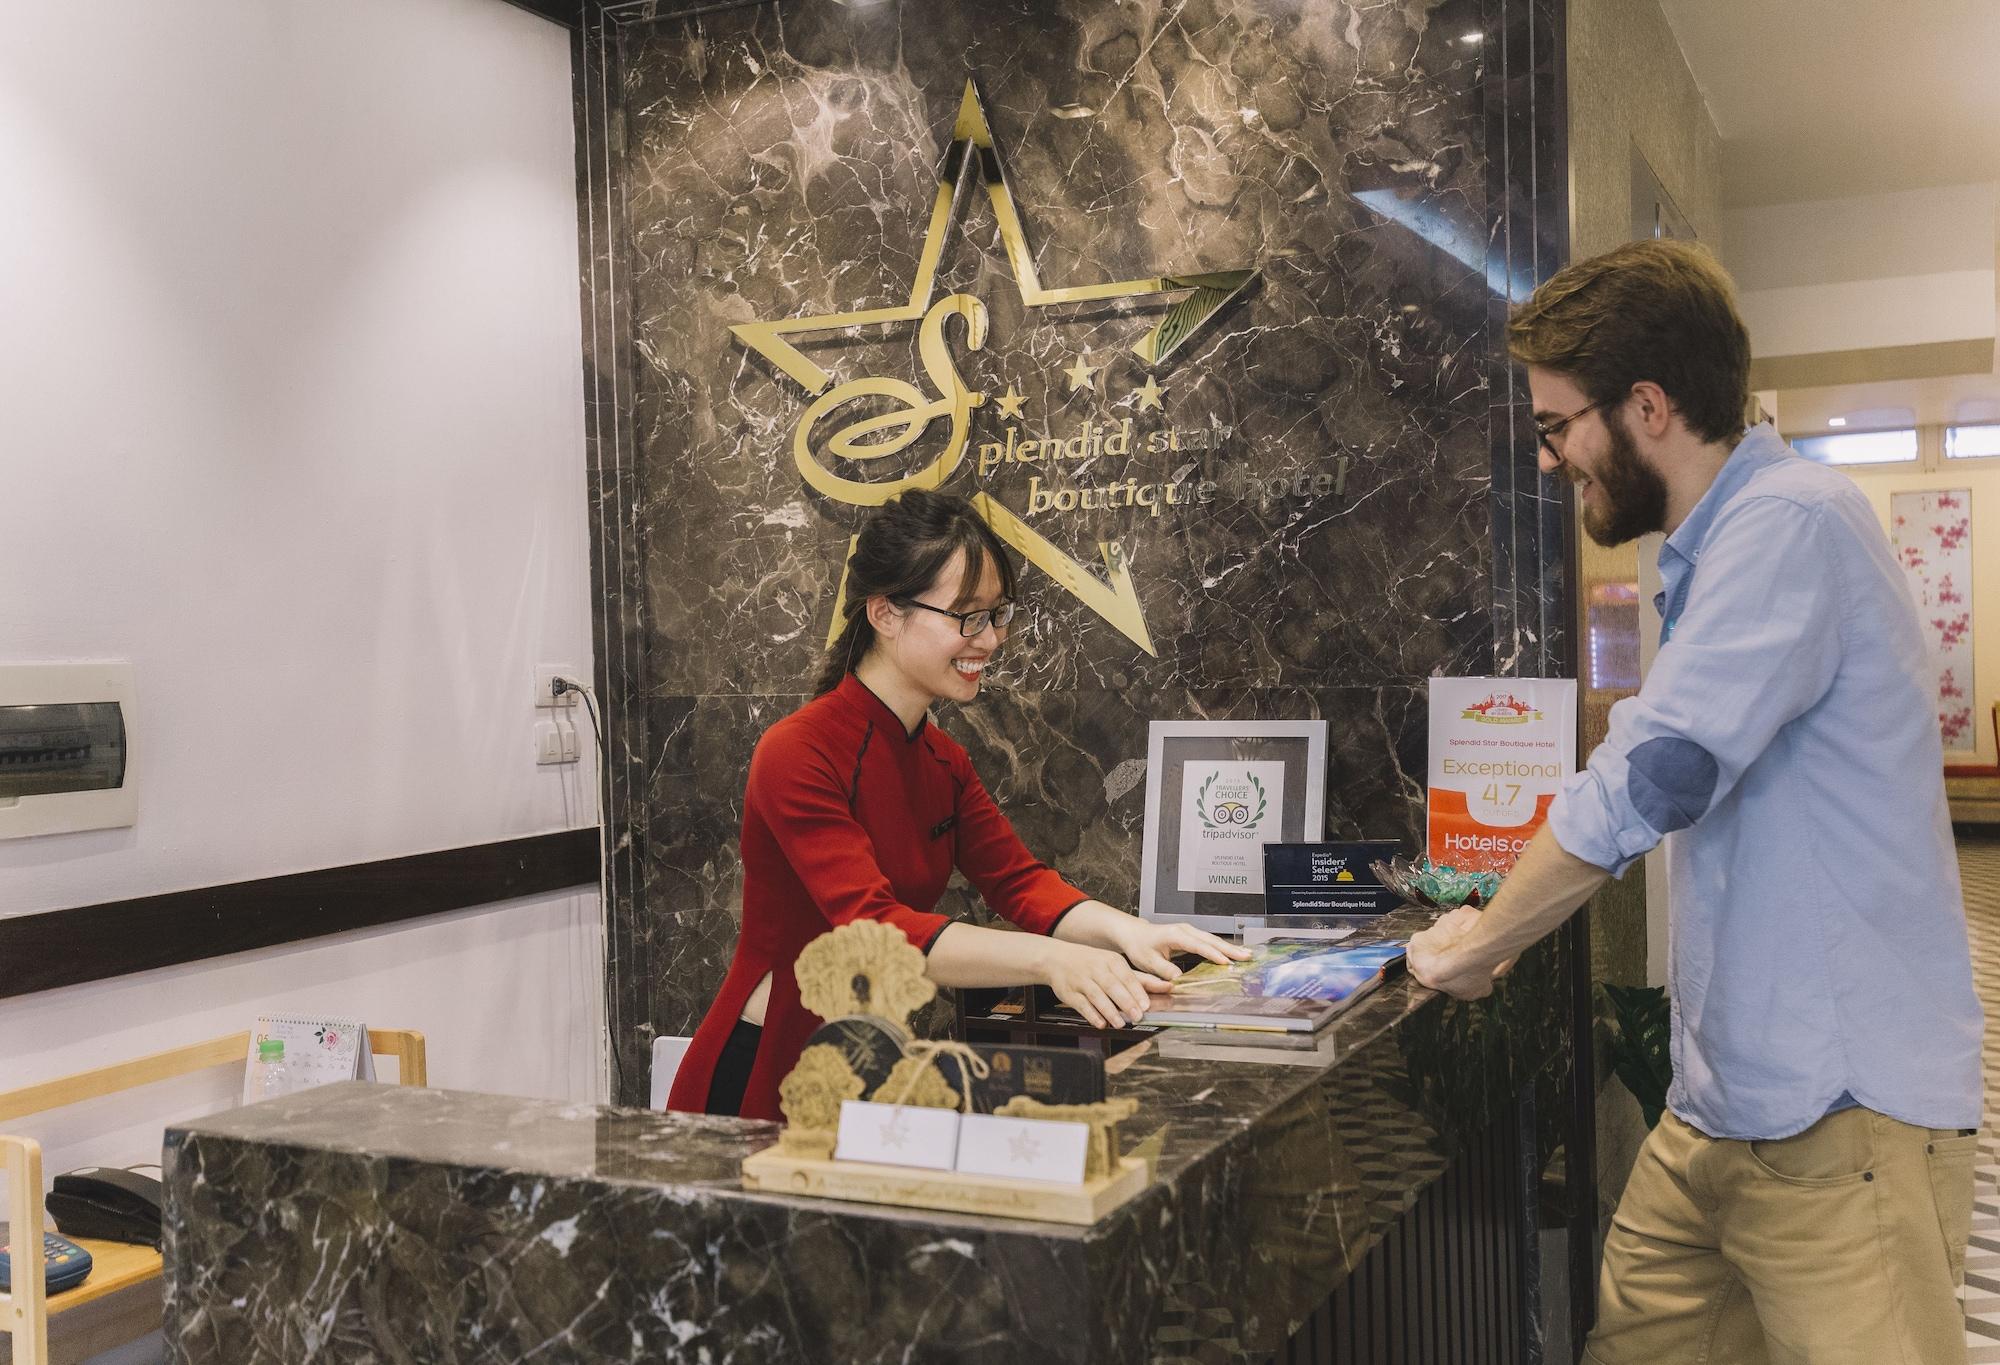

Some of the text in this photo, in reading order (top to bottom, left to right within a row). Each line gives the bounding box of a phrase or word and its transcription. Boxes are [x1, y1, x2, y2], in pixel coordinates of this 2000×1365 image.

[1028, 456, 1350, 517] boutique hotel
[1449, 739, 1481, 747] Splendid
[1500, 740, 1534, 748] Boutique
[1443, 759, 1562, 779] Exceptional
[1215, 791, 1248, 799] CHOICE
[1482, 783, 1522, 806] 4.7
[1202, 829, 1256, 841] tripadvisor
[1208, 875, 1248, 885] WINNER
